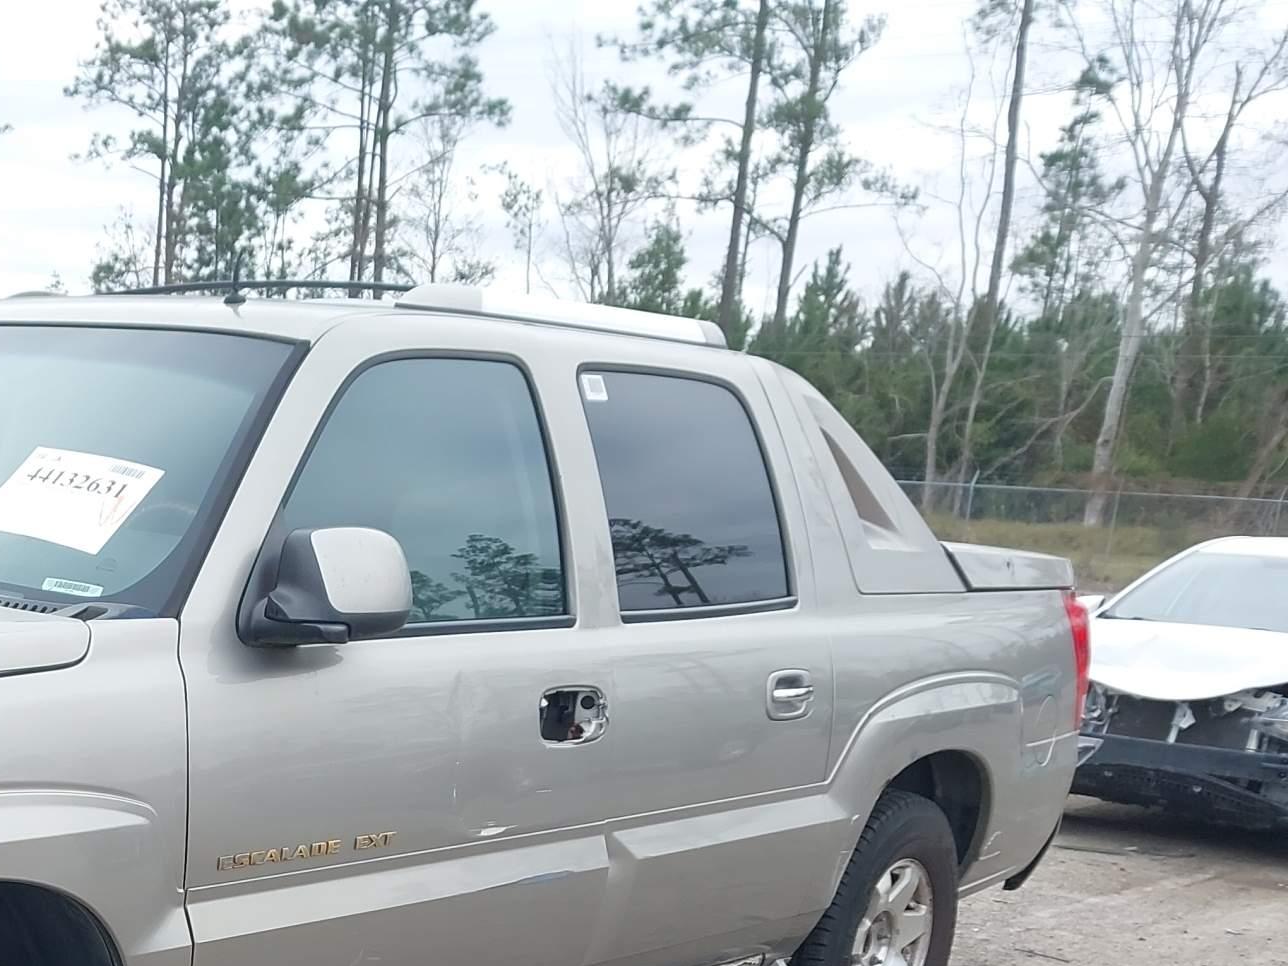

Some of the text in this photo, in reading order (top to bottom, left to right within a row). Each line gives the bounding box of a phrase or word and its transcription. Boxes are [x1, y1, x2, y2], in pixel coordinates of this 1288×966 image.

[27, 467, 128, 498] 44132631
[217, 831, 397, 871] ESCALADE EXT
